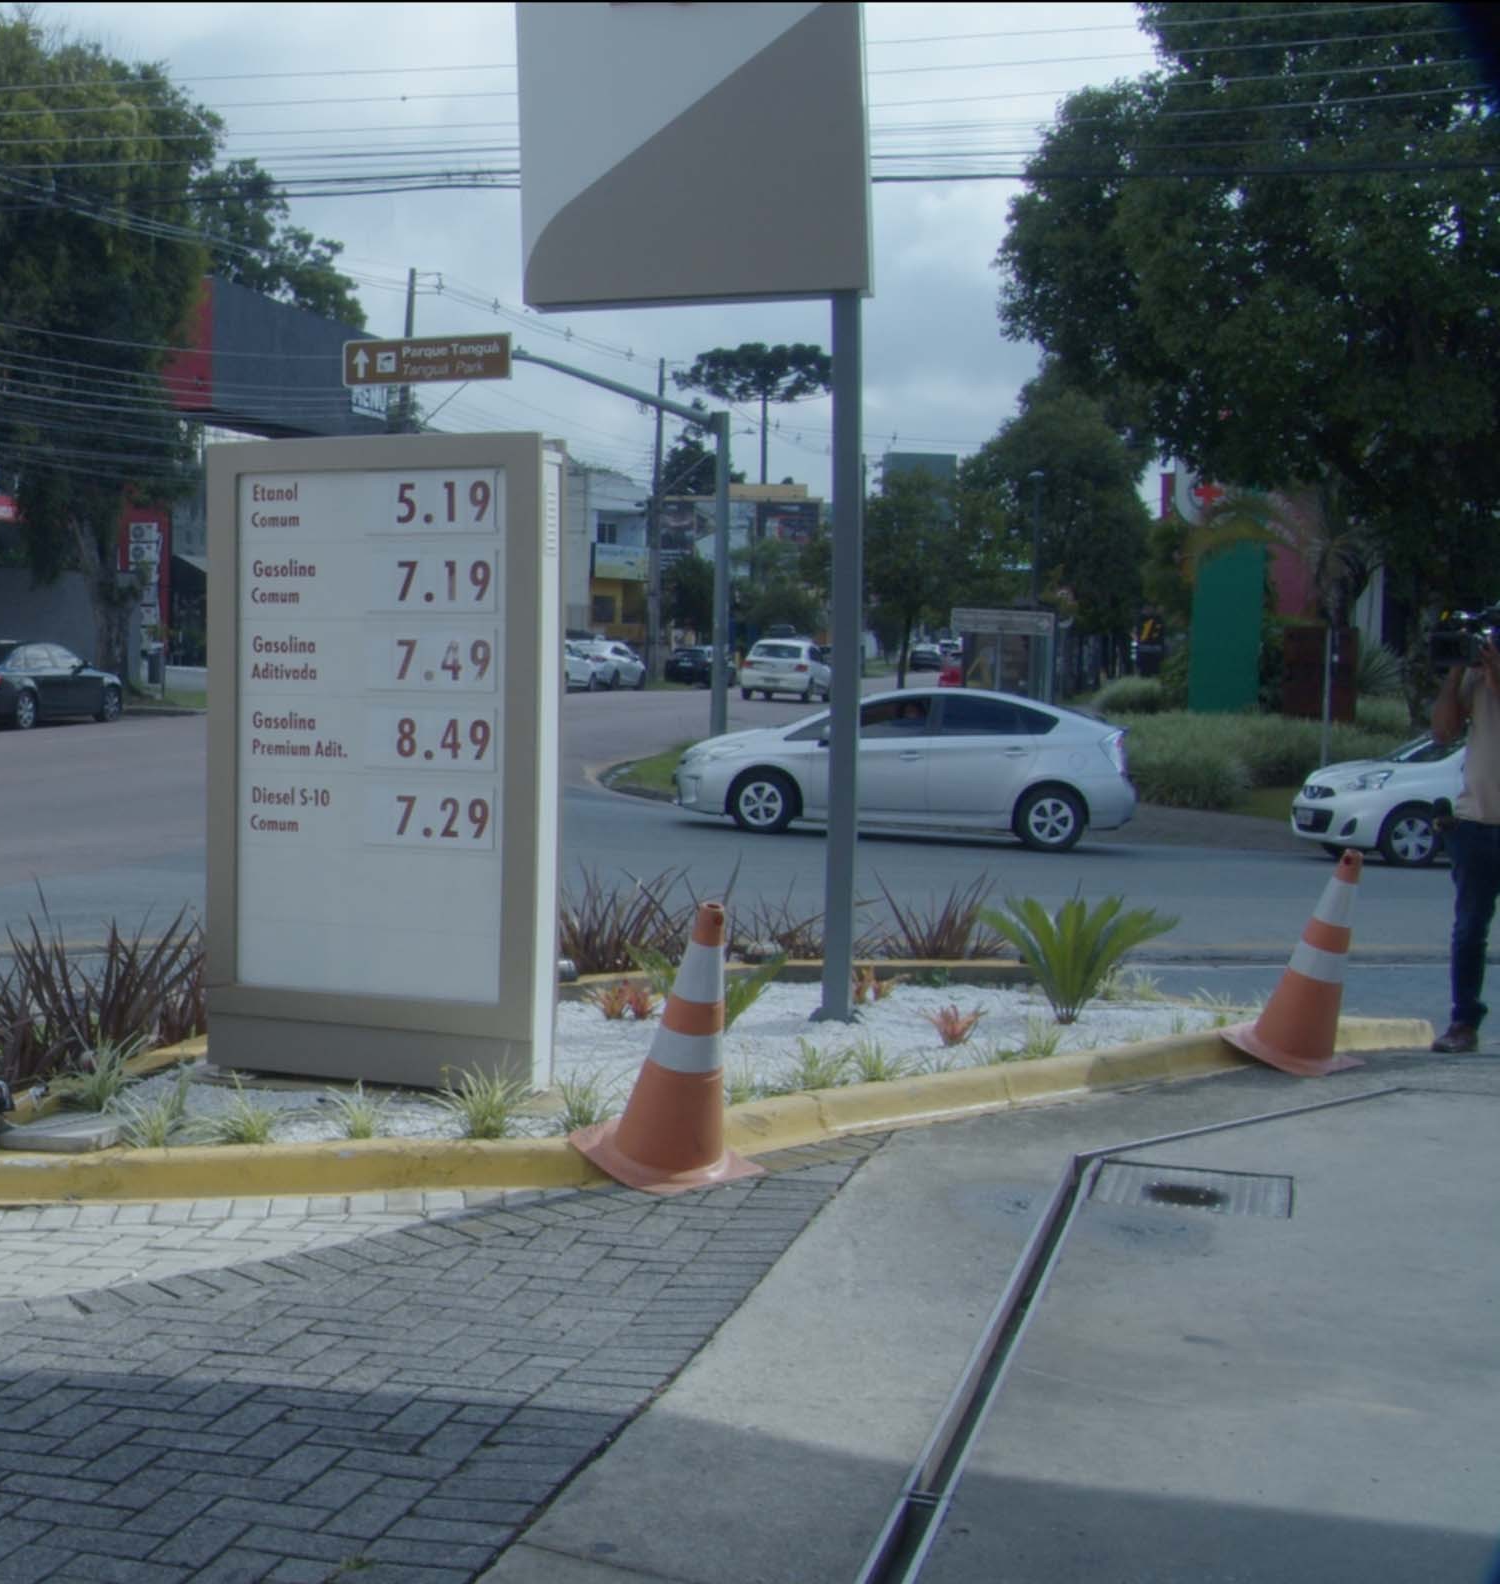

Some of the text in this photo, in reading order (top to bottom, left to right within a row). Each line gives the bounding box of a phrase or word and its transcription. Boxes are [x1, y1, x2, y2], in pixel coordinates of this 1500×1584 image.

[402, 342, 500, 360] Parque Tanguá
[455, 360, 485, 374] Park
[252, 483, 298, 503] Etanol
[395, 479, 491, 525] 5.19
[251, 513, 300, 528] Comum
[253, 559, 316, 578] Gasolina
[396, 559, 492, 603] 7.19
[251, 589, 300, 604] Comum
[253, 635, 316, 654] Gasolina
[395, 638, 492, 682] 7.49
[251, 663, 317, 681] Aditivada
[253, 712, 316, 730] Gasolina
[395, 717, 491, 761] 8.49
[252, 739, 348, 759] Premium Adit.
[252, 787, 330, 807] Diesel S-10
[251, 816, 299, 833] Comum
[395, 795, 490, 839] 7.29
